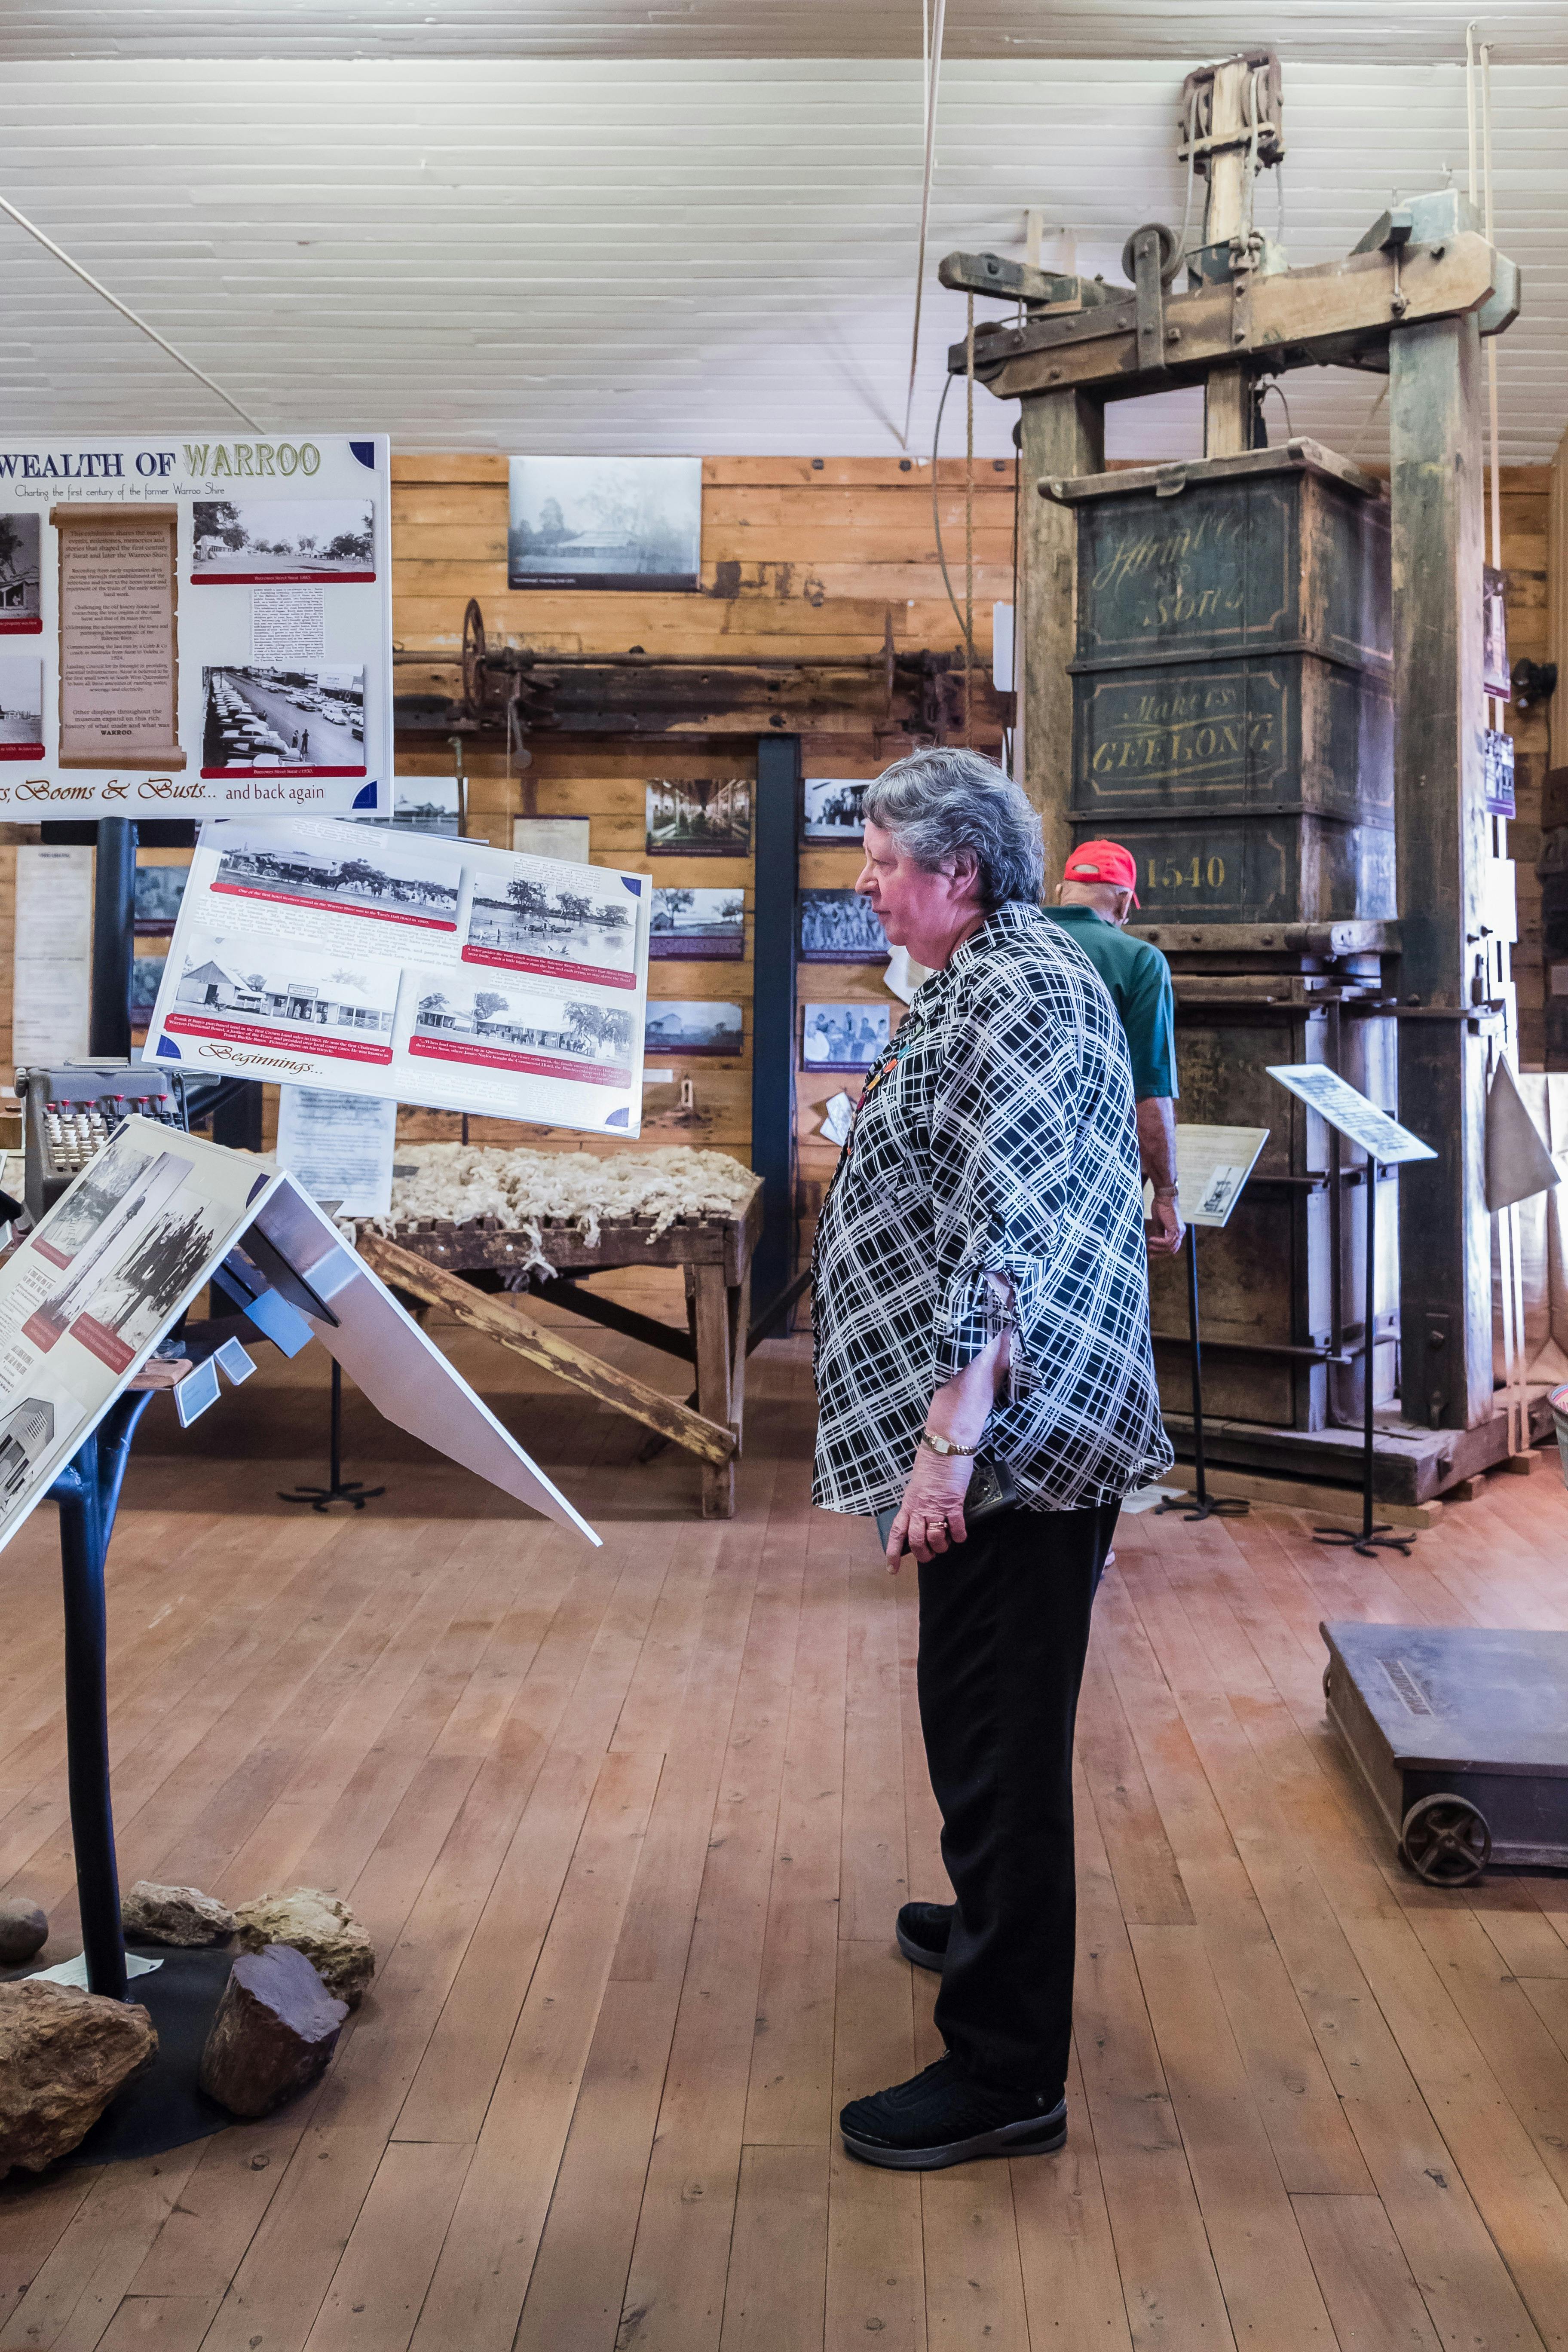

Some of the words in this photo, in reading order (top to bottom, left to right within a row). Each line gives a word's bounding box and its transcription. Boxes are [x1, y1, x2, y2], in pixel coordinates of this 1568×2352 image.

[135, 452, 176, 477] OF
[182, 442, 321, 477] WARROO
[15, 484, 49, 501] Charting
[52, 484, 64, 496] the
[67, 484, 82, 501] first
[86, 487, 113, 500] century
[117, 483, 126, 500] of
[130, 483, 141, 495] the
[145, 483, 169, 500] former
[173, 482, 201, 495] Warroo
[205, 482, 225, 495] Shire
[91, 709, 115, 717] displays
[1093, 721, 1275, 772] GEELONG
[15, 779, 96, 800] Booms
[101, 780, 131, 799] &
[138, 778, 216, 799] Busts...
[226, 784, 250, 799] and
[255, 784, 285, 799] back
[289, 785, 324, 805] again
[1145, 856, 1226, 888] 1540
[199, 1043, 323, 1075] Beginnings...
